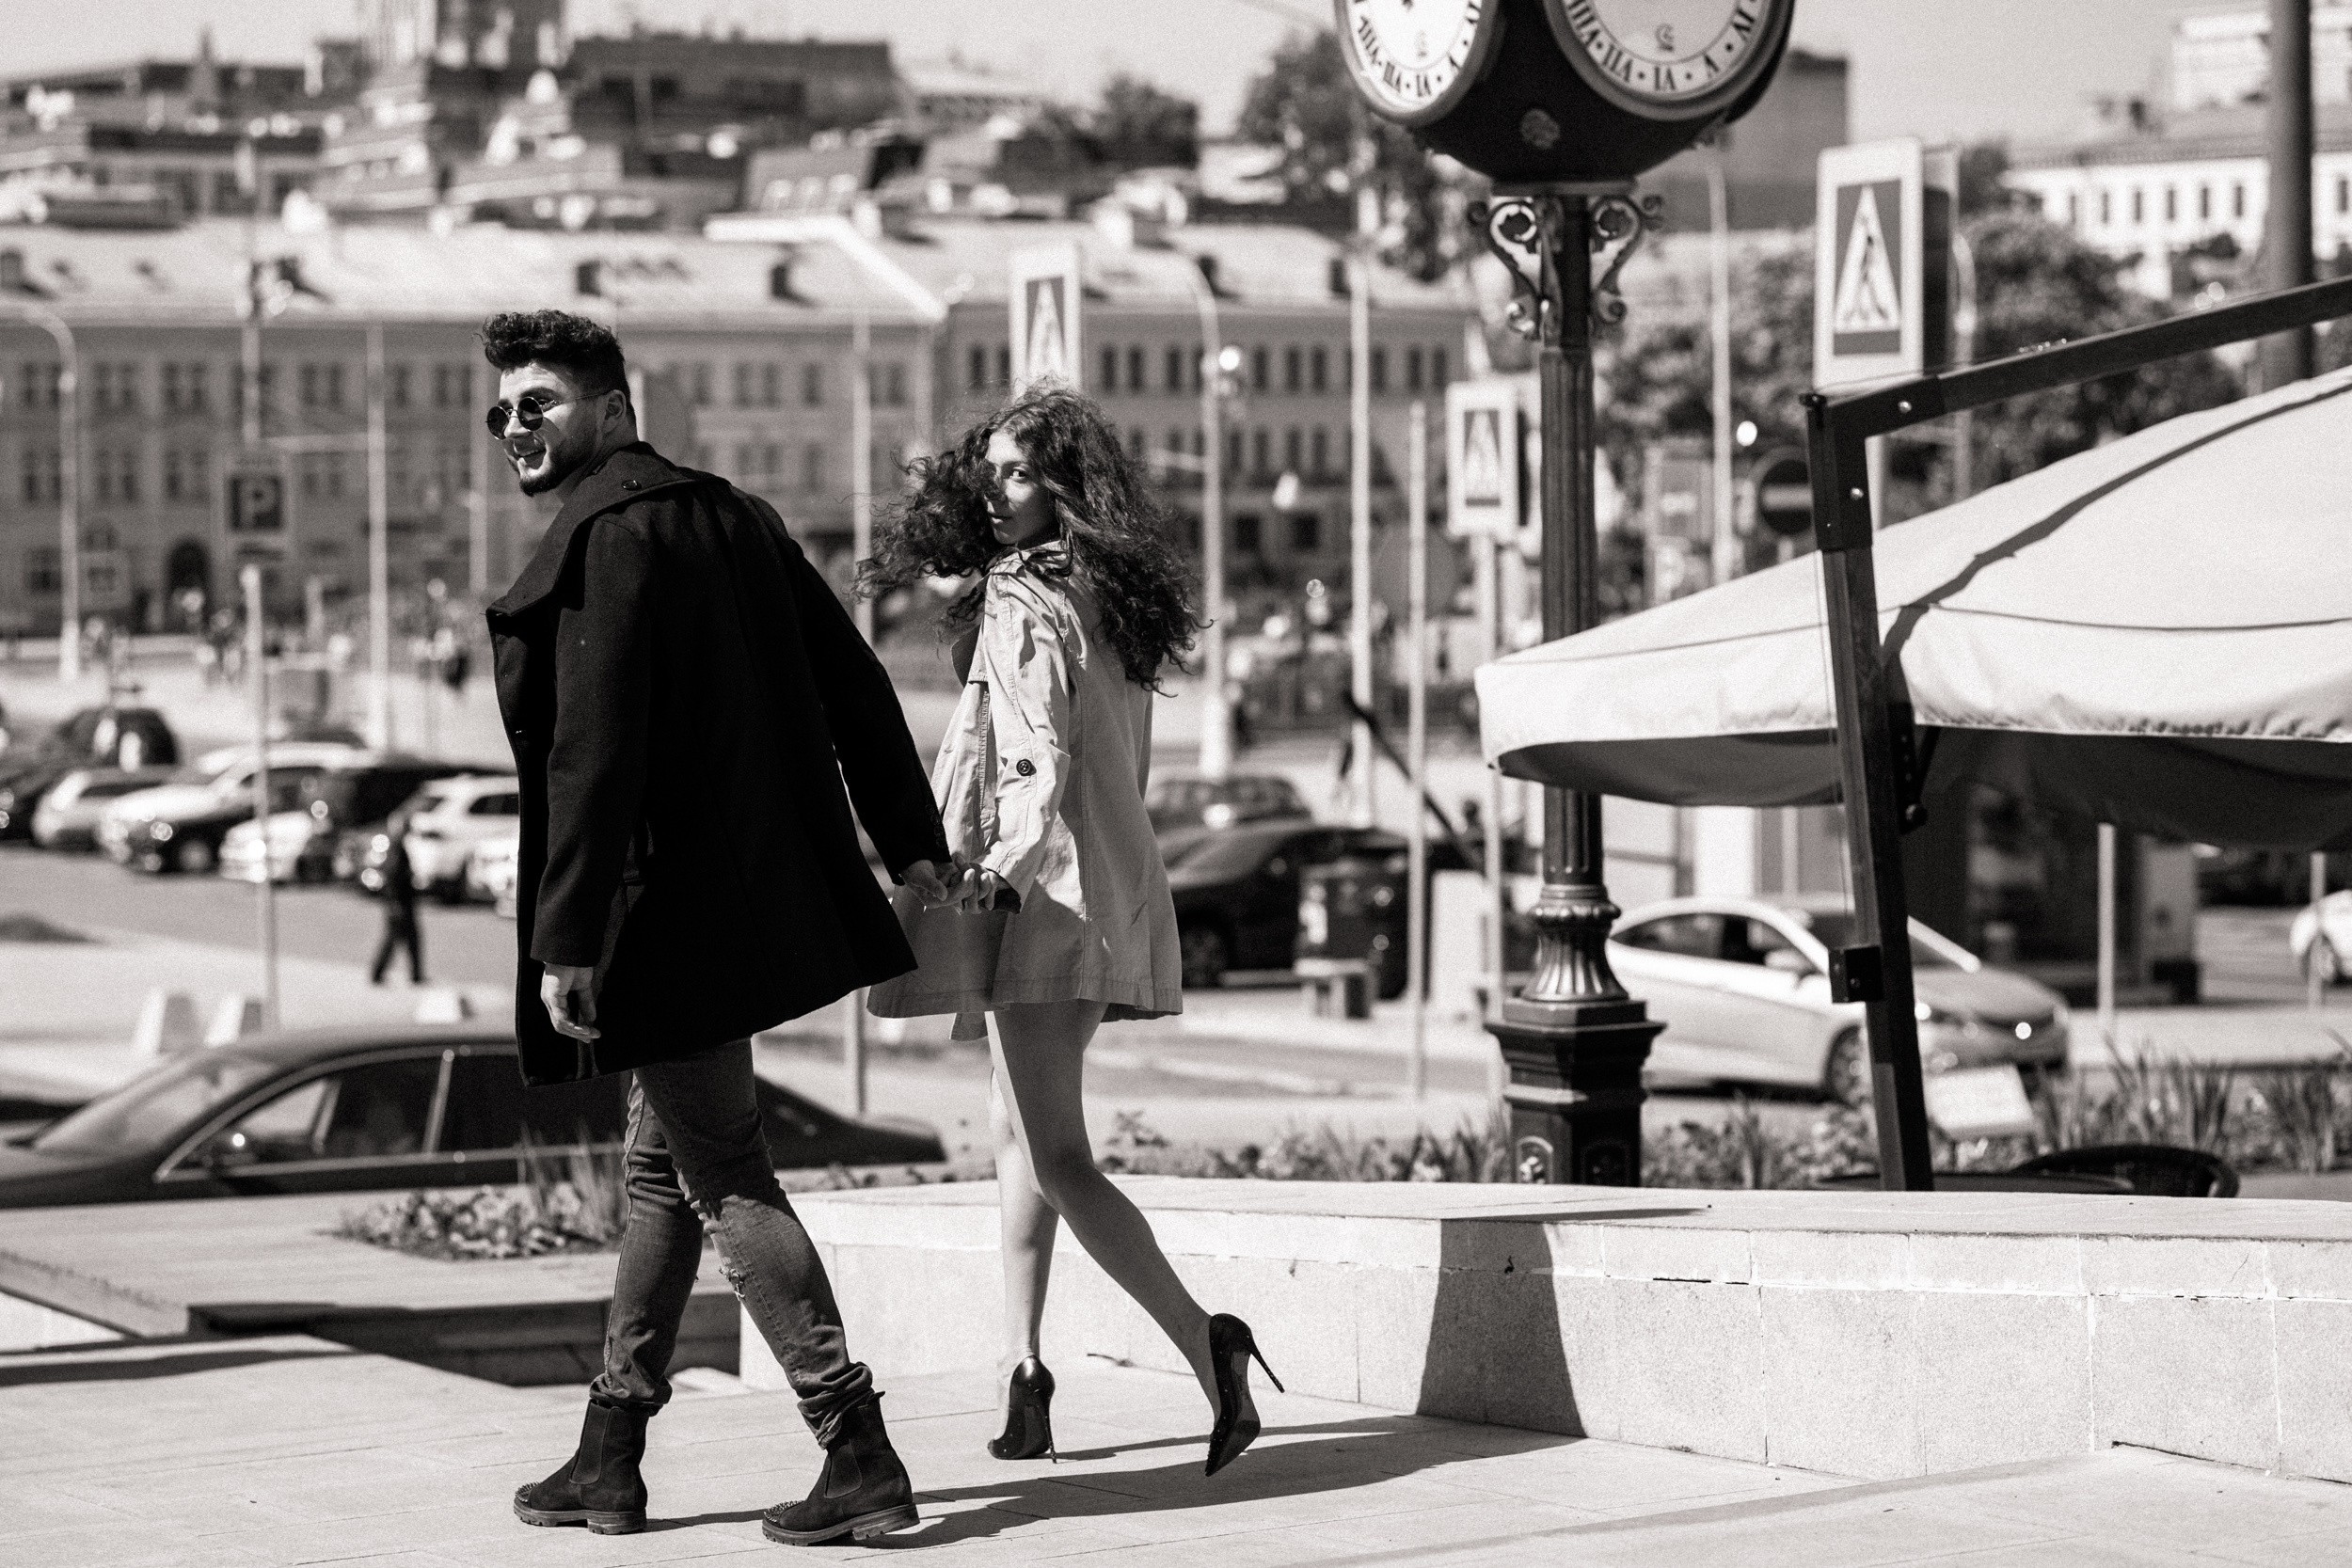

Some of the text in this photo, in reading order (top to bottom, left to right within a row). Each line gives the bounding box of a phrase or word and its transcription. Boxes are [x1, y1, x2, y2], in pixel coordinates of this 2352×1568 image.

[1733, 7, 1756, 44] IV
[1601, 43, 1633, 83] VII
[1654, 66, 1676, 91] VI
[1703, 54, 1720, 79] V
[1415, 74, 1432, 98] VI
[240, 478, 277, 527] P
